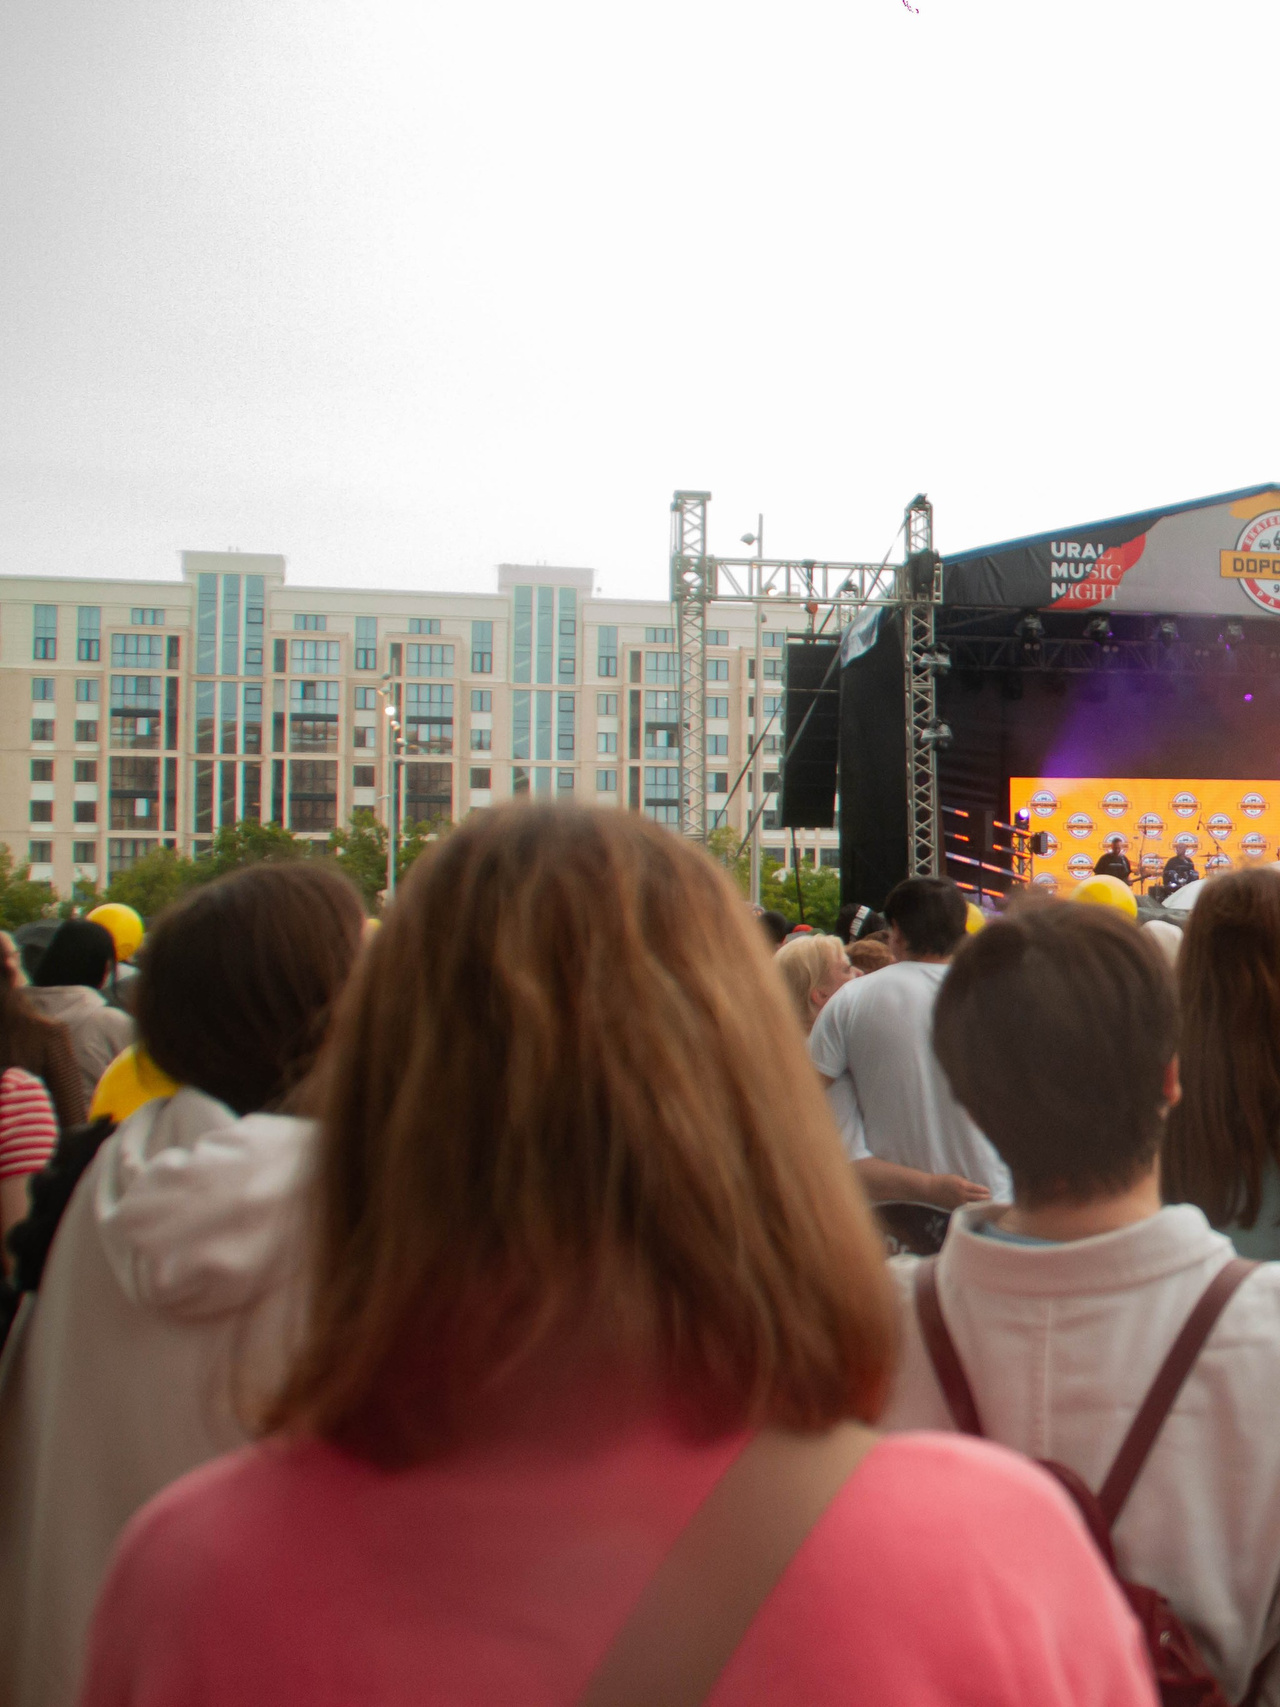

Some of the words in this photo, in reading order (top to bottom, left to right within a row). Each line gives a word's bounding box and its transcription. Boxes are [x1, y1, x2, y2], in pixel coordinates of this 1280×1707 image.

[1050, 541, 1112, 560] URAL
[1050, 561, 1122, 581] MUSIC
[1050, 582, 1121, 601] NIGHT
